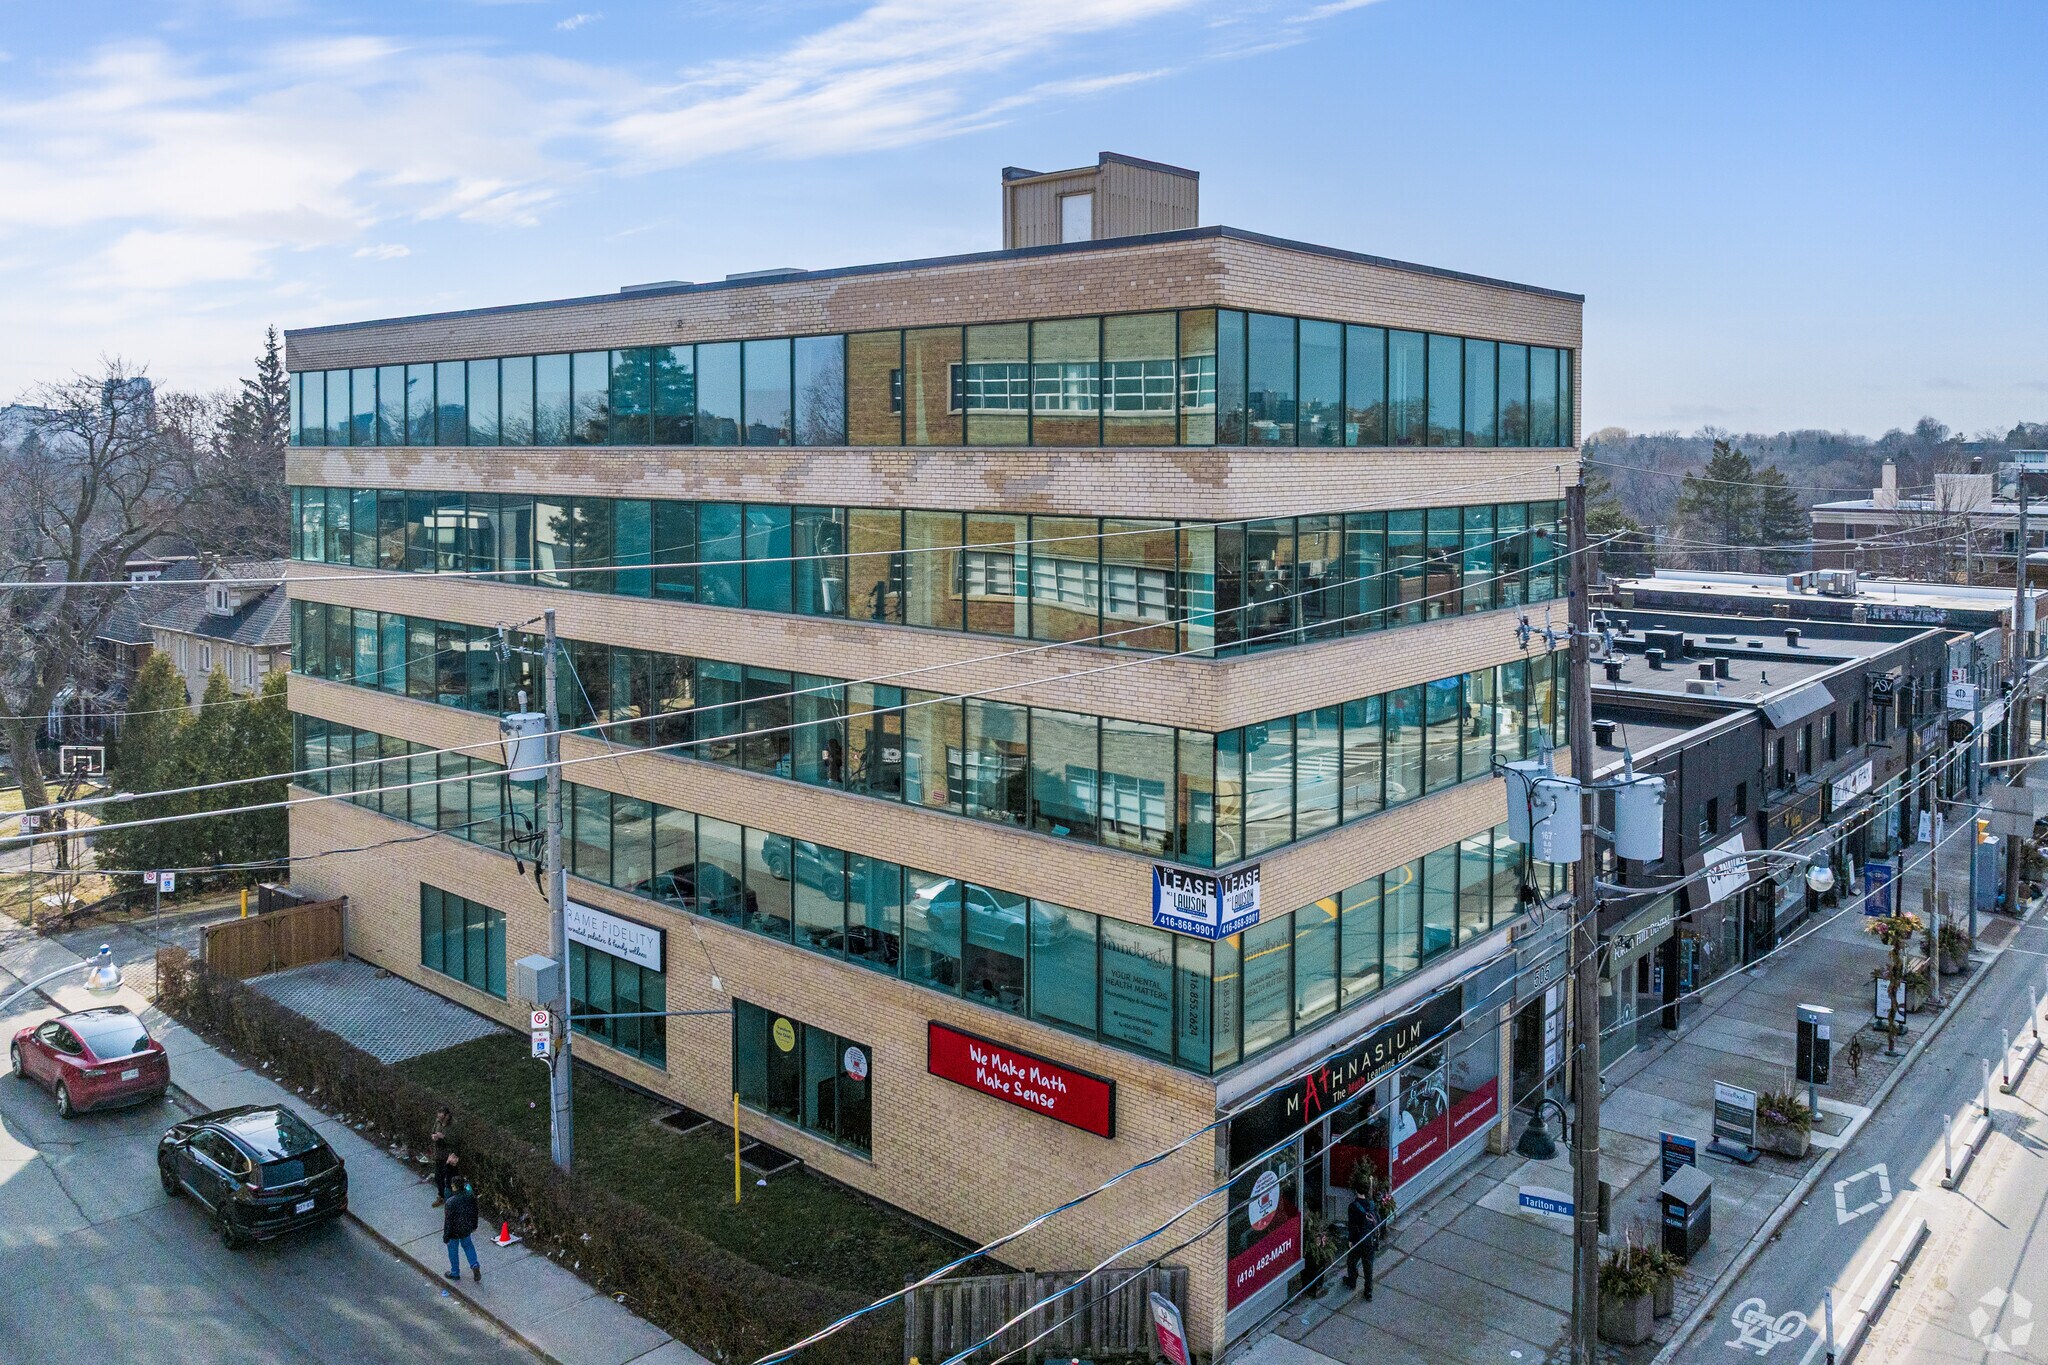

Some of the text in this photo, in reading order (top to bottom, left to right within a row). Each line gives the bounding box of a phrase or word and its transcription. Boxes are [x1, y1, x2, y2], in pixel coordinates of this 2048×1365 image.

[1164, 872, 1215, 896] LEASE
[1224, 869, 1259, 894] LEASE
[1173, 892, 1207, 913] LAWSON
[567, 908, 654, 948] RAME FIDELITY
[1160, 914, 1215, 937] 416-868-9901
[1221, 912, 1259, 934] 416-868-9901
[1636, 929, 1649, 946] HILL
[1111, 969, 1161, 989] YOUR MENTAL
[1534, 962, 1551, 989] 505
[1105, 976, 1168, 1001] HEALTH MATTERS
[969, 1044, 1067, 1094] We Make Math
[1332, 1088, 1346, 1103] The
[1366, 1058, 1396, 1082] Learning
[976, 1068, 1055, 1109] Make Sense
[1525, 1196, 1568, 1214] Tarlton Rd
[1236, 1238, 1292, 1288] (416) 482-MATH
